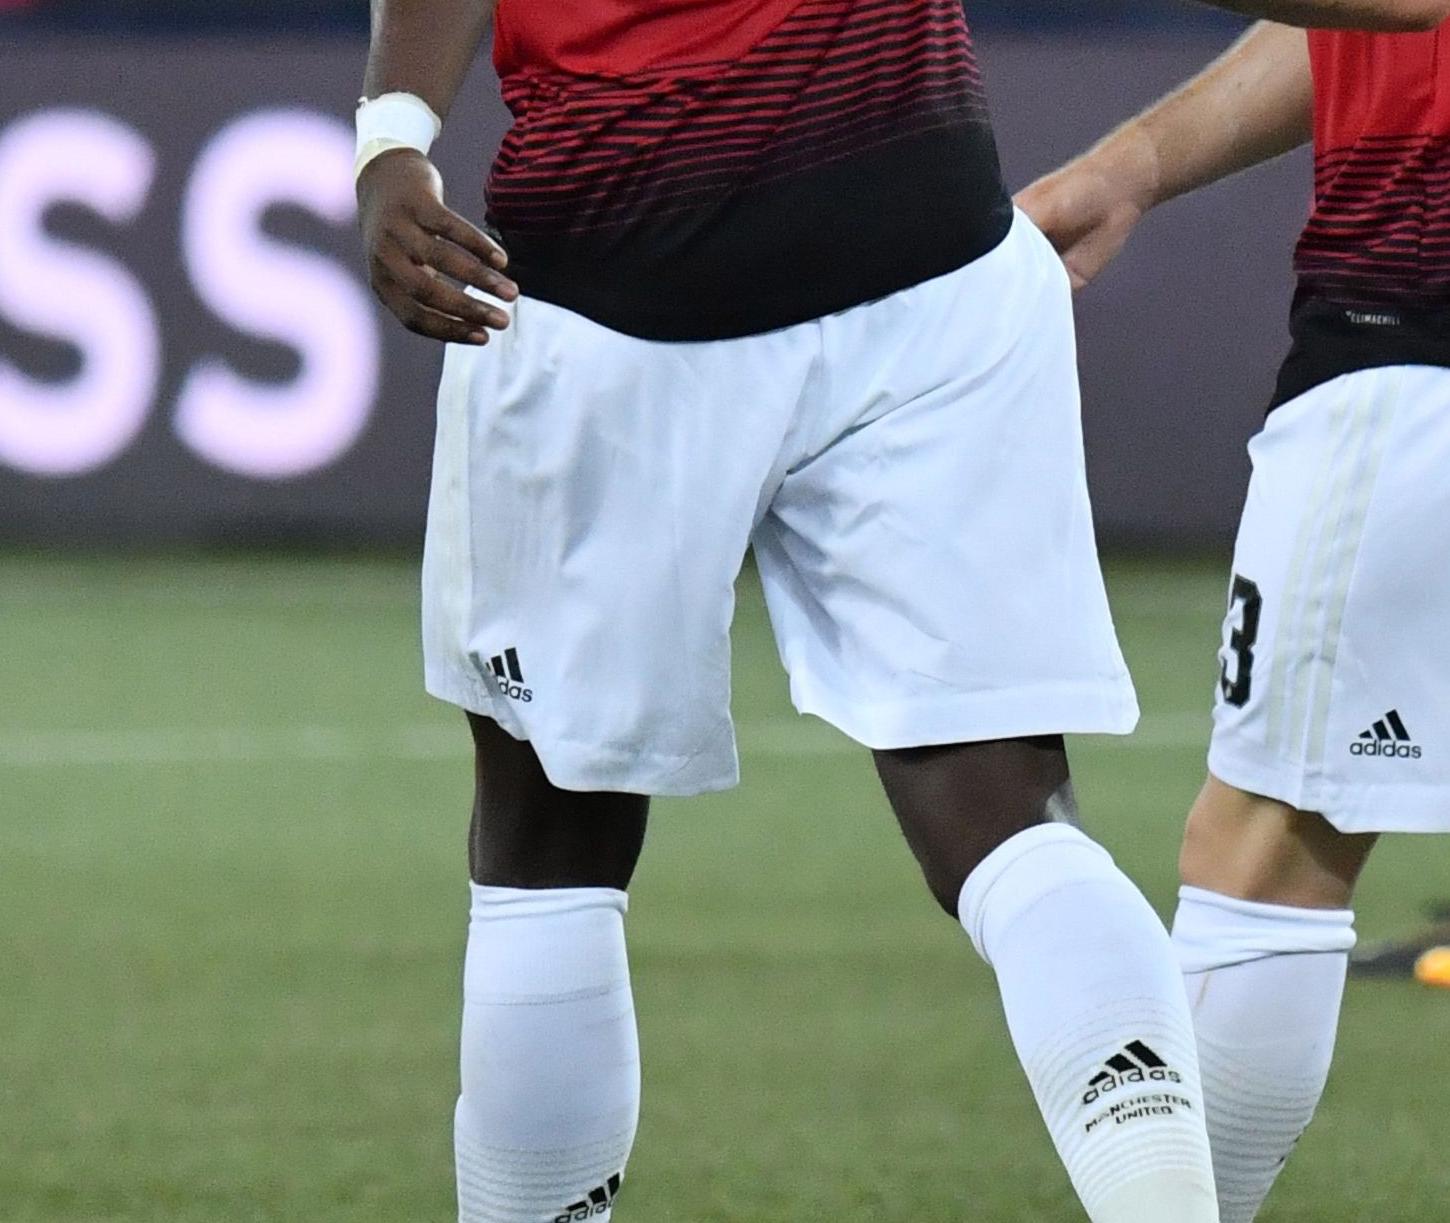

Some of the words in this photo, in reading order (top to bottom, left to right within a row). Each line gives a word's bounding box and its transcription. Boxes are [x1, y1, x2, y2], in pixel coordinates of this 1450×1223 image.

[1349, 737, 1422, 759] adidas
[1082, 1067, 1181, 1105] adidas
[1115, 1105, 1173, 1124] UNITED
